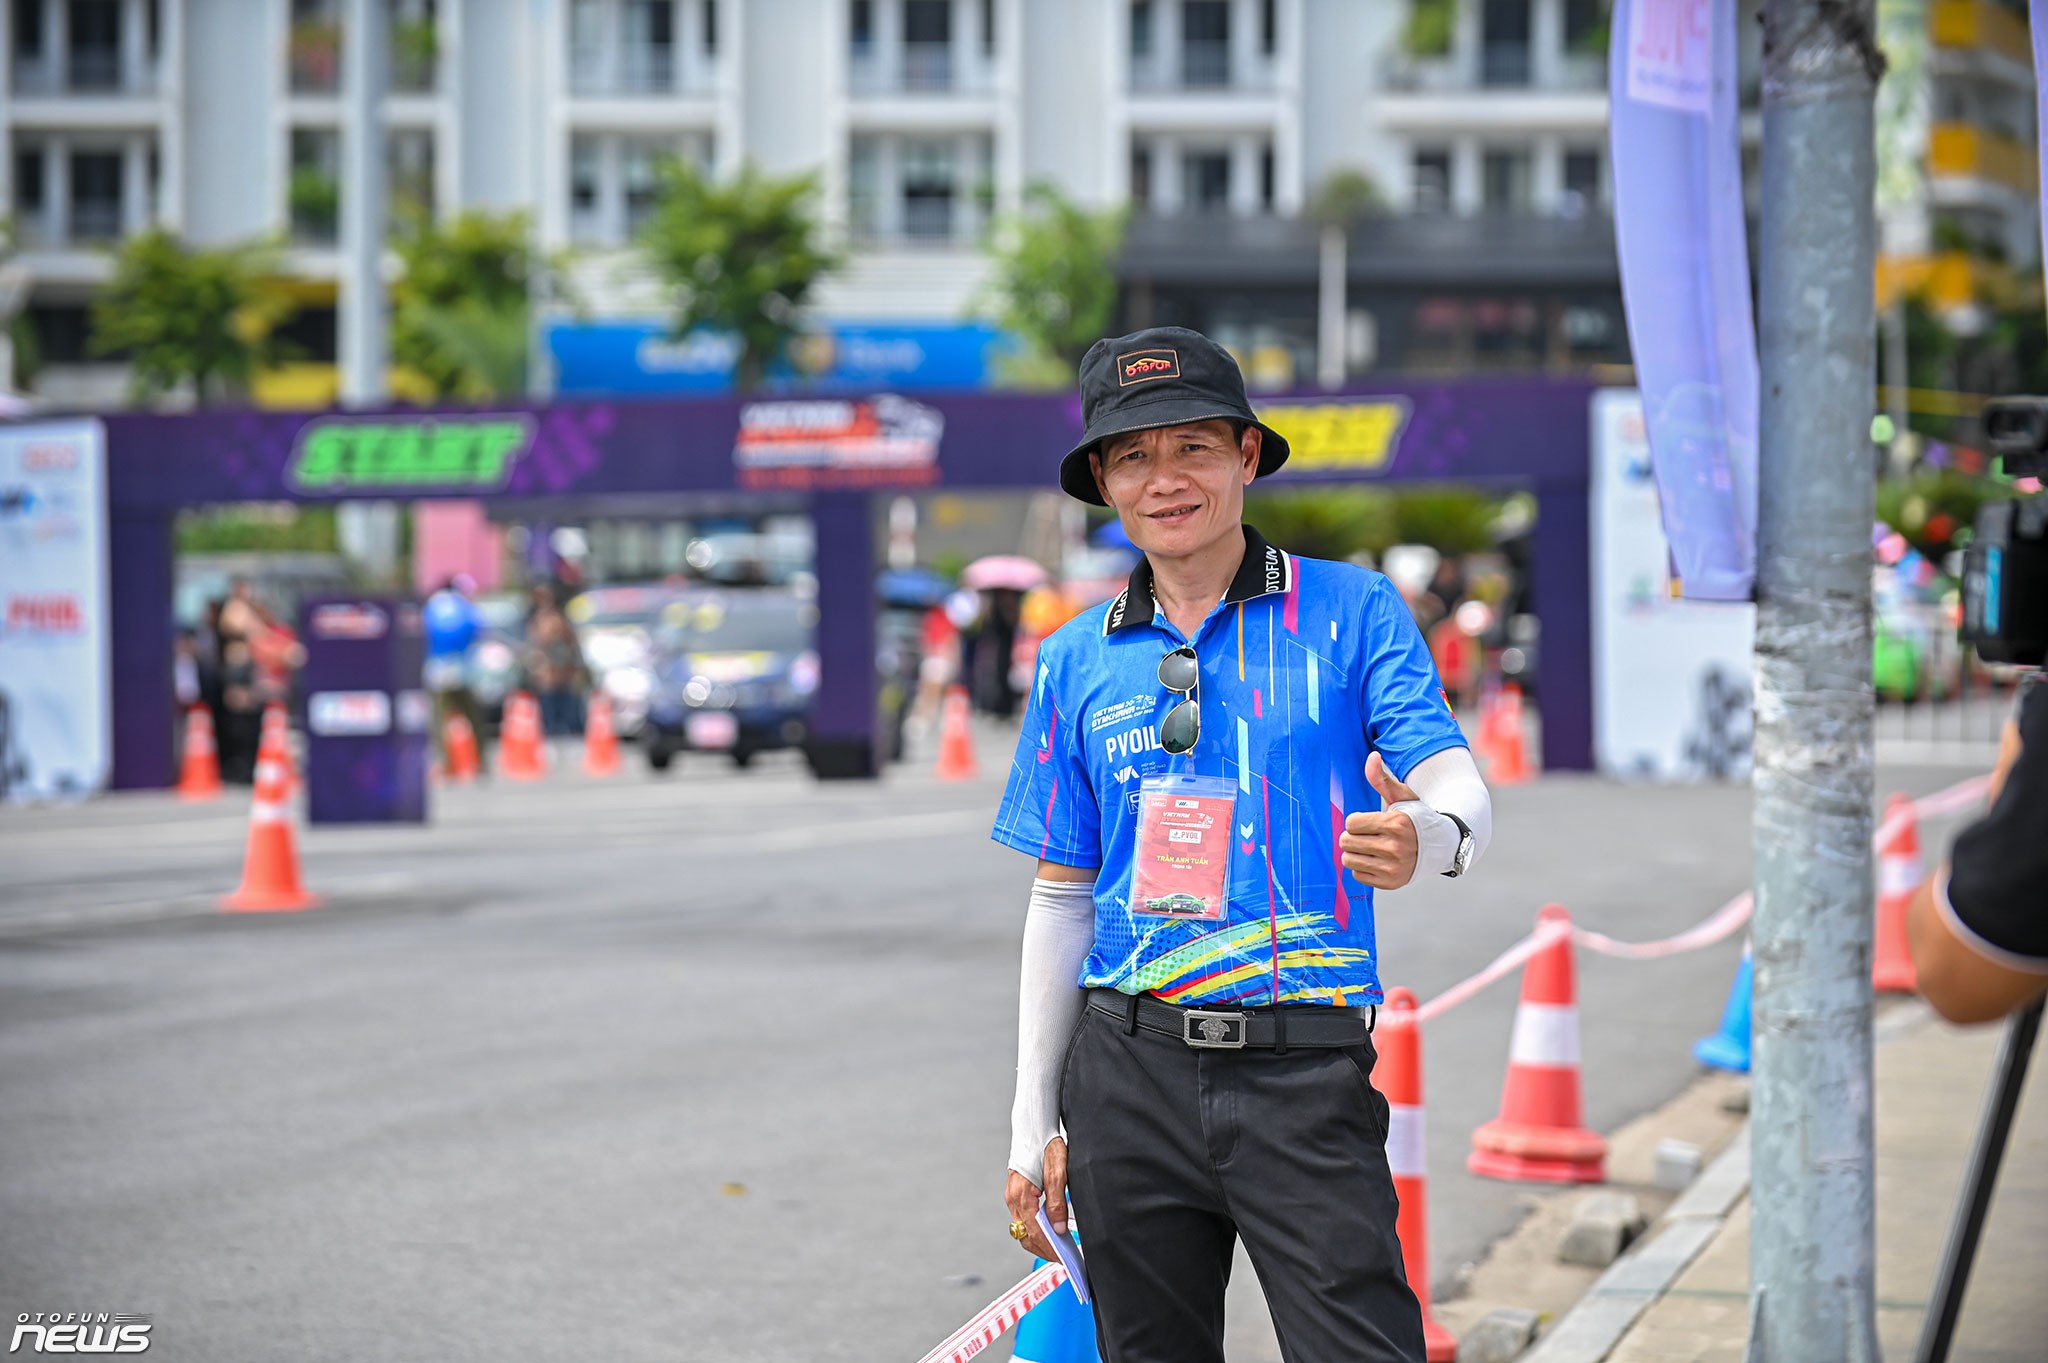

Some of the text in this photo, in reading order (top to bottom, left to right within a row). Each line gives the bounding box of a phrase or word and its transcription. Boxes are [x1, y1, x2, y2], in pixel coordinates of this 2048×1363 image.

[1126, 361, 1173, 377] OTOFUN
[297, 423, 524, 487] START
[1091, 706, 1135, 727] GYMKHANA
[1092, 701, 1125, 719] VIETNAM
[1105, 725, 1162, 763] PVOIL
[1181, 831, 1199, 839] PVOIL
